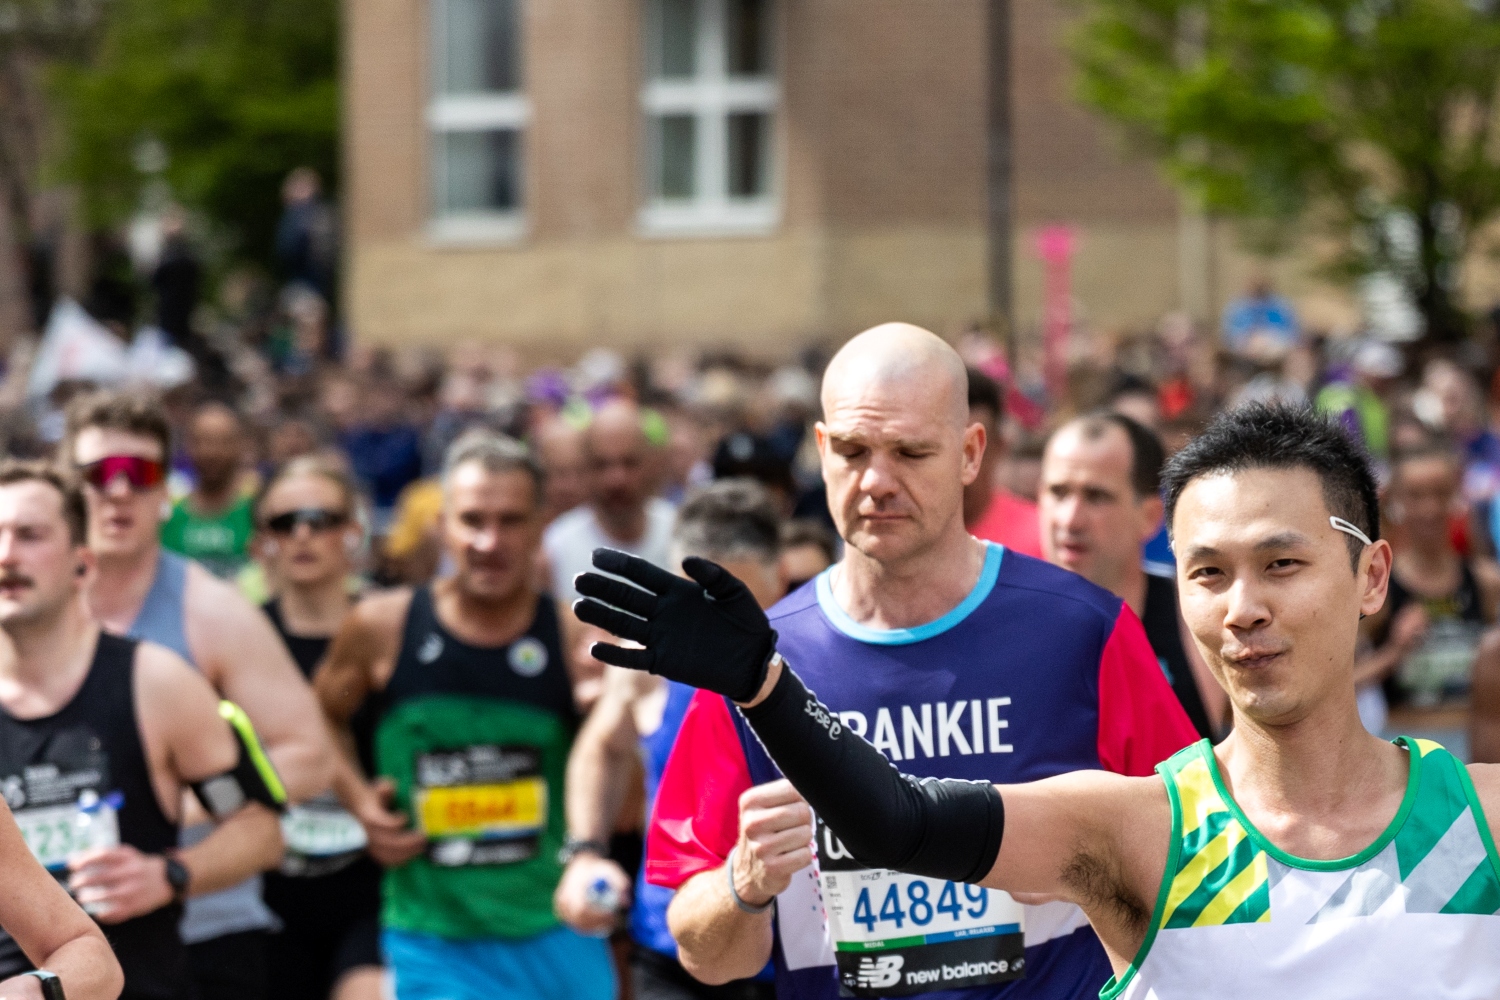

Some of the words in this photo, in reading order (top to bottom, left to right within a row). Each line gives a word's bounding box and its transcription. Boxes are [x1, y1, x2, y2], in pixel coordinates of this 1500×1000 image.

[853, 881, 989, 933] 44849
[906, 968, 940, 986] new
[942, 959, 1009, 981] balance
